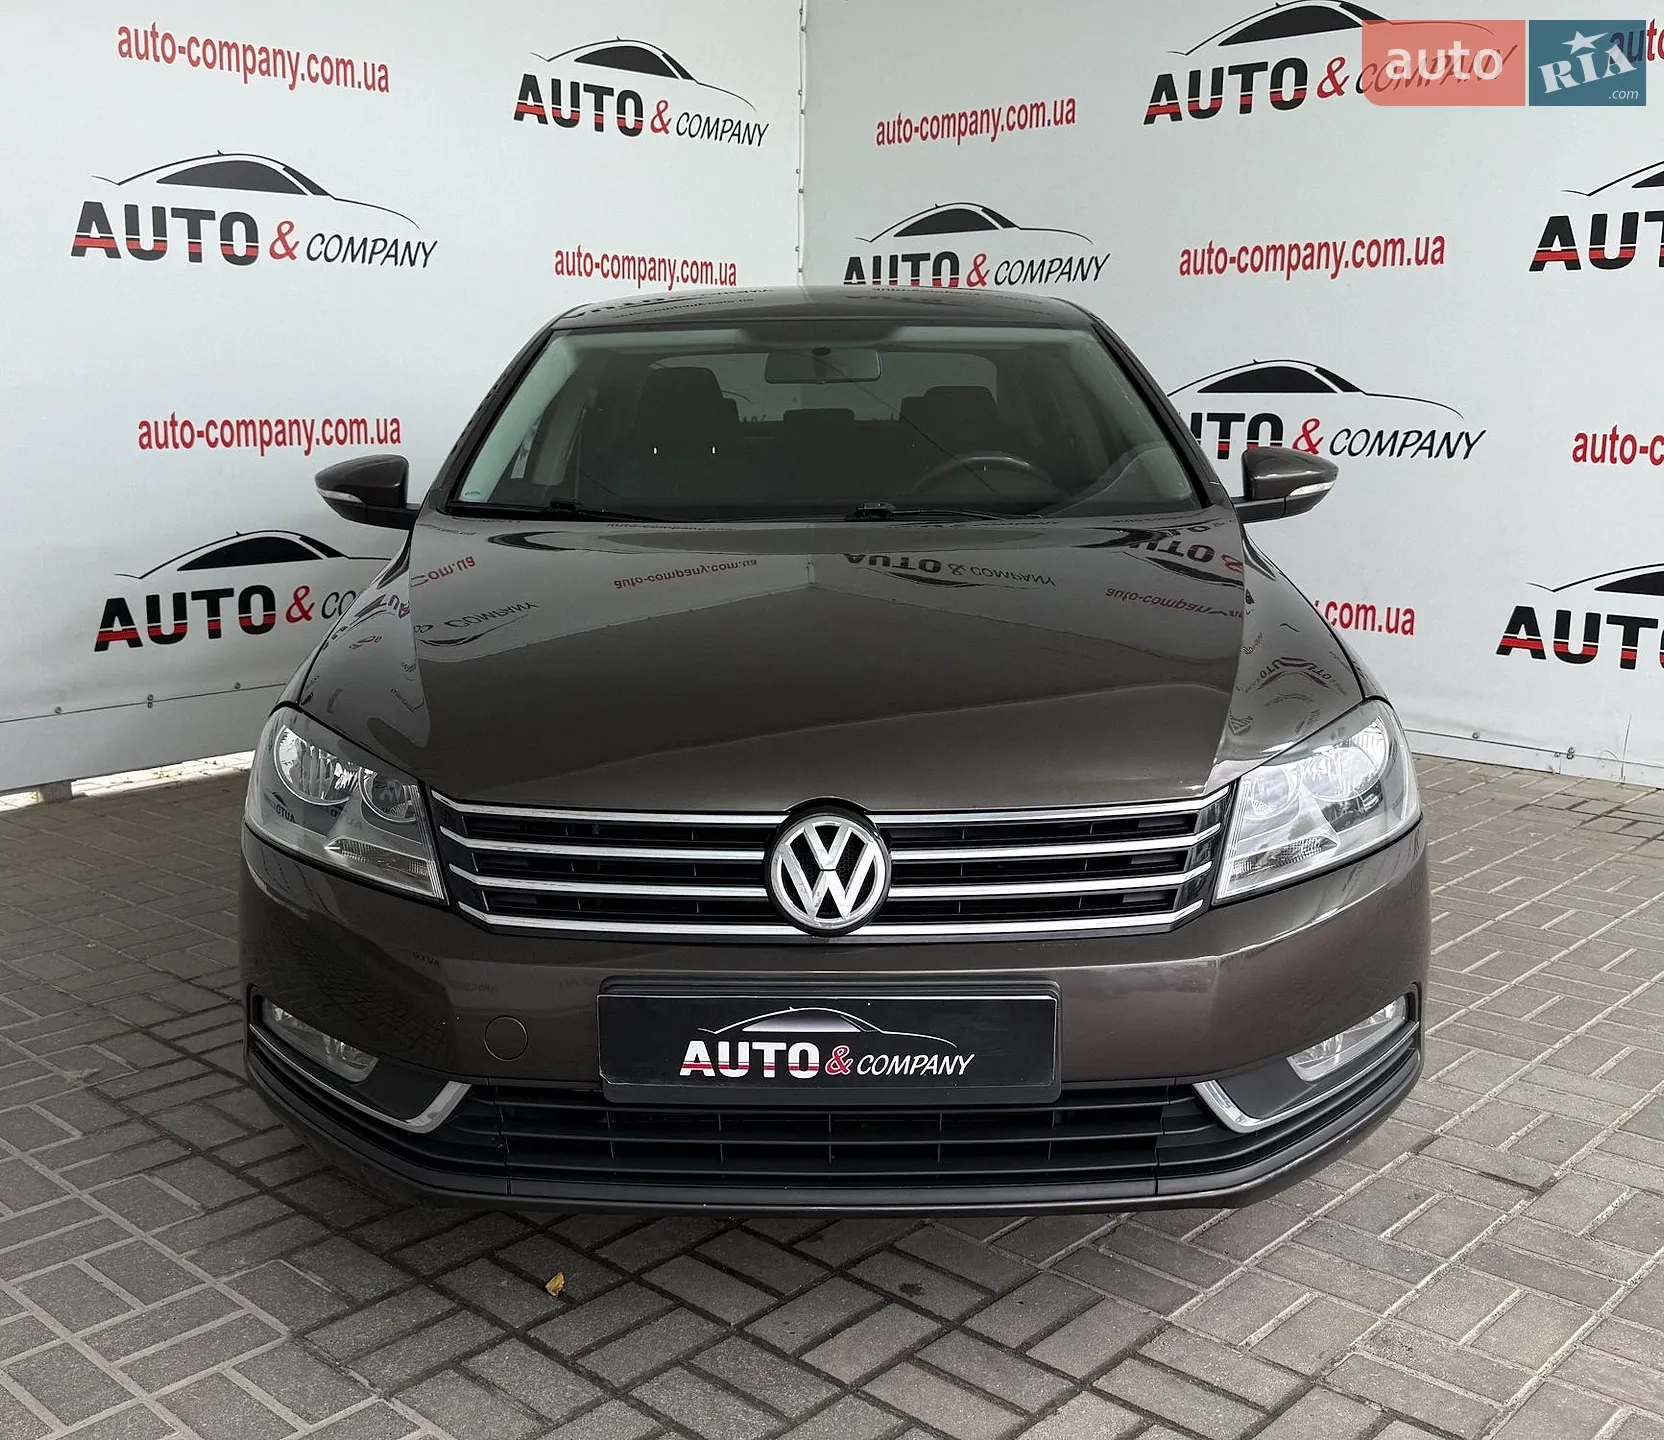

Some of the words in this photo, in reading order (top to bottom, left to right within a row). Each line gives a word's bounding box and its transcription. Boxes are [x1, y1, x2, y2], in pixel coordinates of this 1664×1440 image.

[118, 23, 390, 92] auto-company.com.ua
[514, 73, 643, 137] AUTO
[650, 100, 672, 134] &
[676, 112, 769, 147] COMPANY
[1143, 56, 1308, 125] AUTO
[1316, 56, 1349, 99] &
[876, 97, 1076, 145] auto-company.com.ua
[71, 200, 259, 266] AUTO
[269, 220, 299, 260] &
[306, 233, 438, 268] COMPANY
[1179, 234, 1446, 281] auto-company.com.ua
[555, 245, 737, 289] auto-company.com.ua
[843, 251, 960, 288] AUTO
[966, 253, 991, 288] &
[994, 253, 1111, 285] COMPANY
[138, 413, 402, 456] auto-company.com.ua
[1292, 418, 1324, 456] &
[1329, 428, 1487, 460] COMPANY
[94, 584, 276, 652] AUTO
[284, 585, 315, 624] &
[1496, 605, 1664, 670] AUT
[680, 1040, 820, 1079] AUTO
[824, 1045, 853, 1076] &
[857, 1053, 975, 1076] COMPANY
